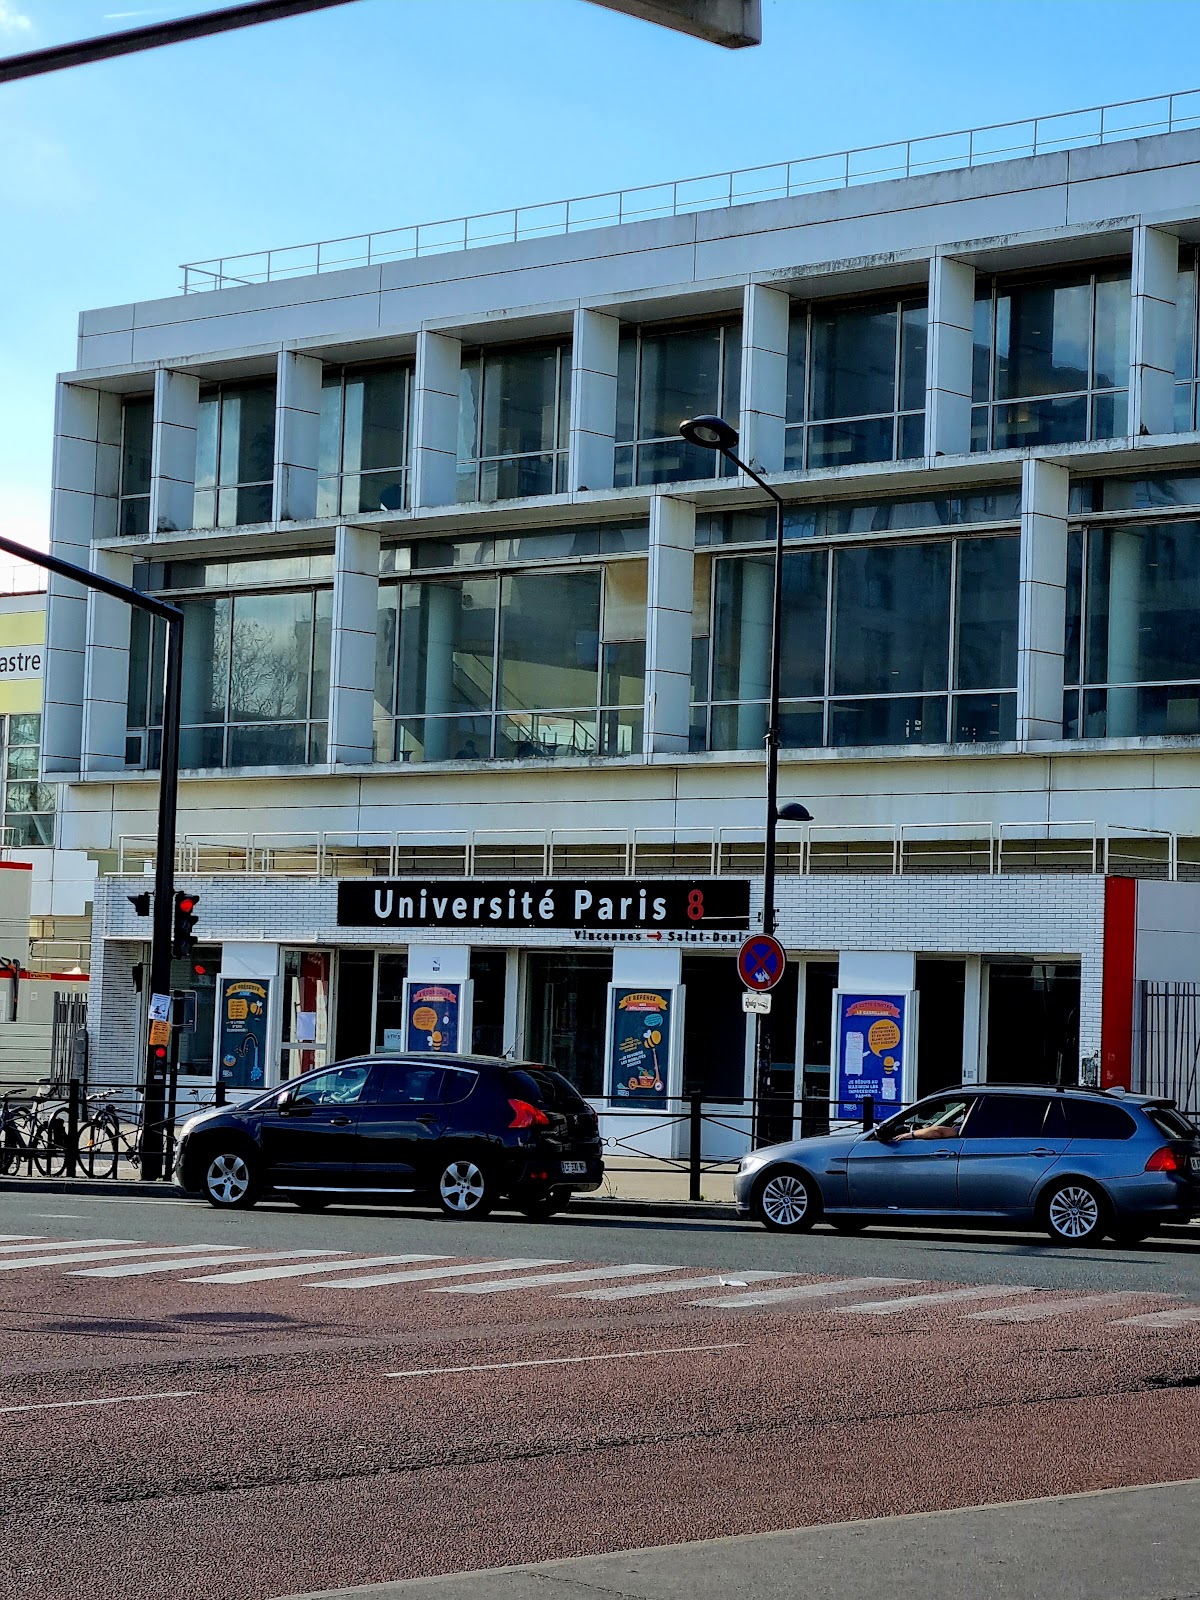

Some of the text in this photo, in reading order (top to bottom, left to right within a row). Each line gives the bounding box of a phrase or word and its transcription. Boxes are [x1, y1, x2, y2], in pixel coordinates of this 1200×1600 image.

[0, 652, 41, 673] astre
[374, 888, 704, 921] Université Paris 8
[574, 930, 642, 941] Vincennes
